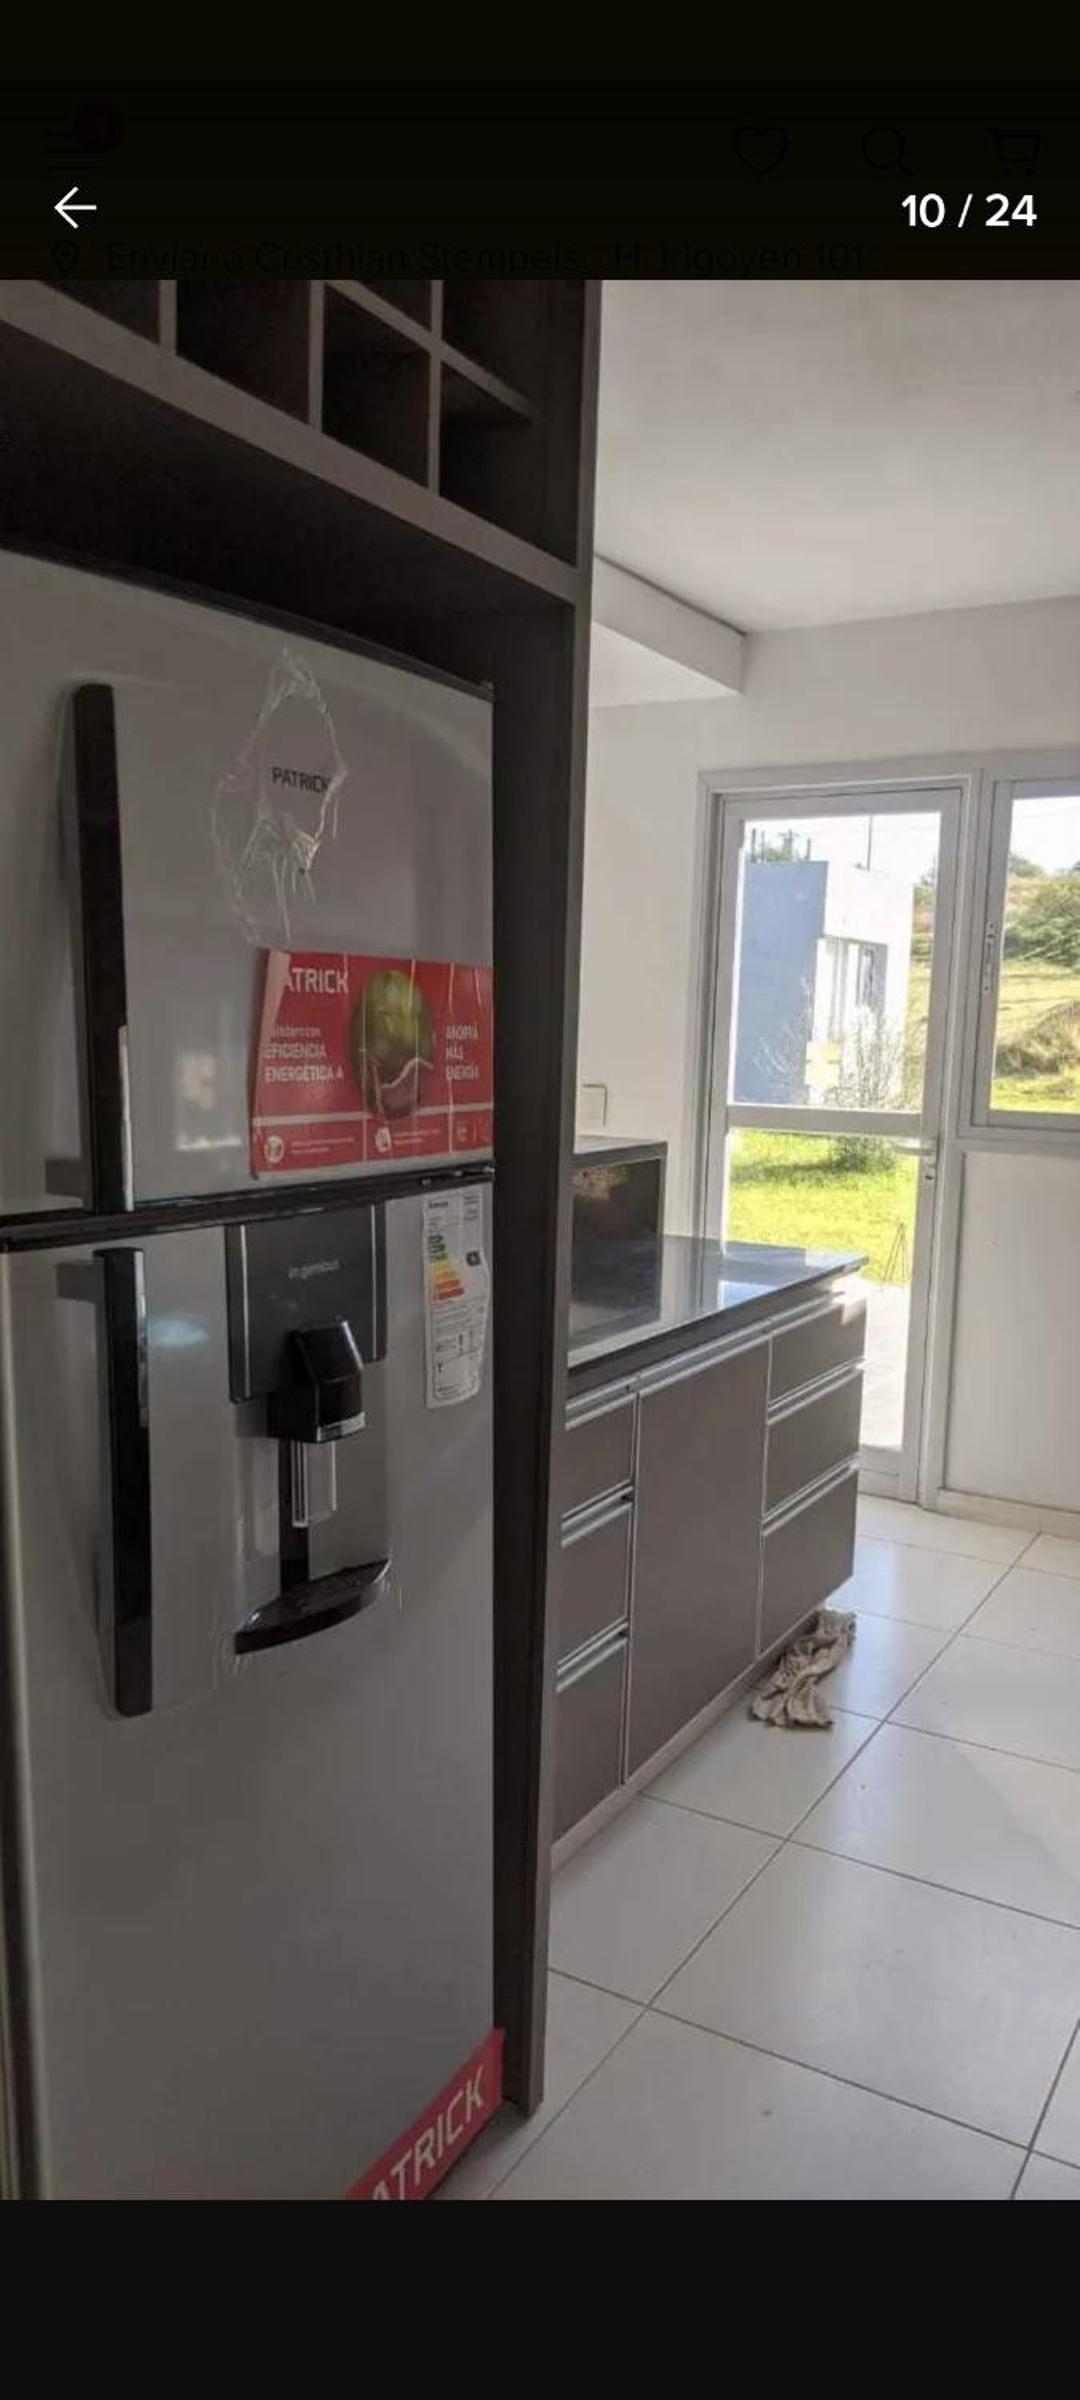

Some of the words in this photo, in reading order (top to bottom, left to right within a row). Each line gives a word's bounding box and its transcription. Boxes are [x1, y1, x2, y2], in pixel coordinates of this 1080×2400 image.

[271, 766, 333, 793] PATRICK
[284, 966, 349, 995] ATRICK
[263, 1042, 327, 1059] EFICIENCIA
[370, 2064, 485, 2201] ATRICK
